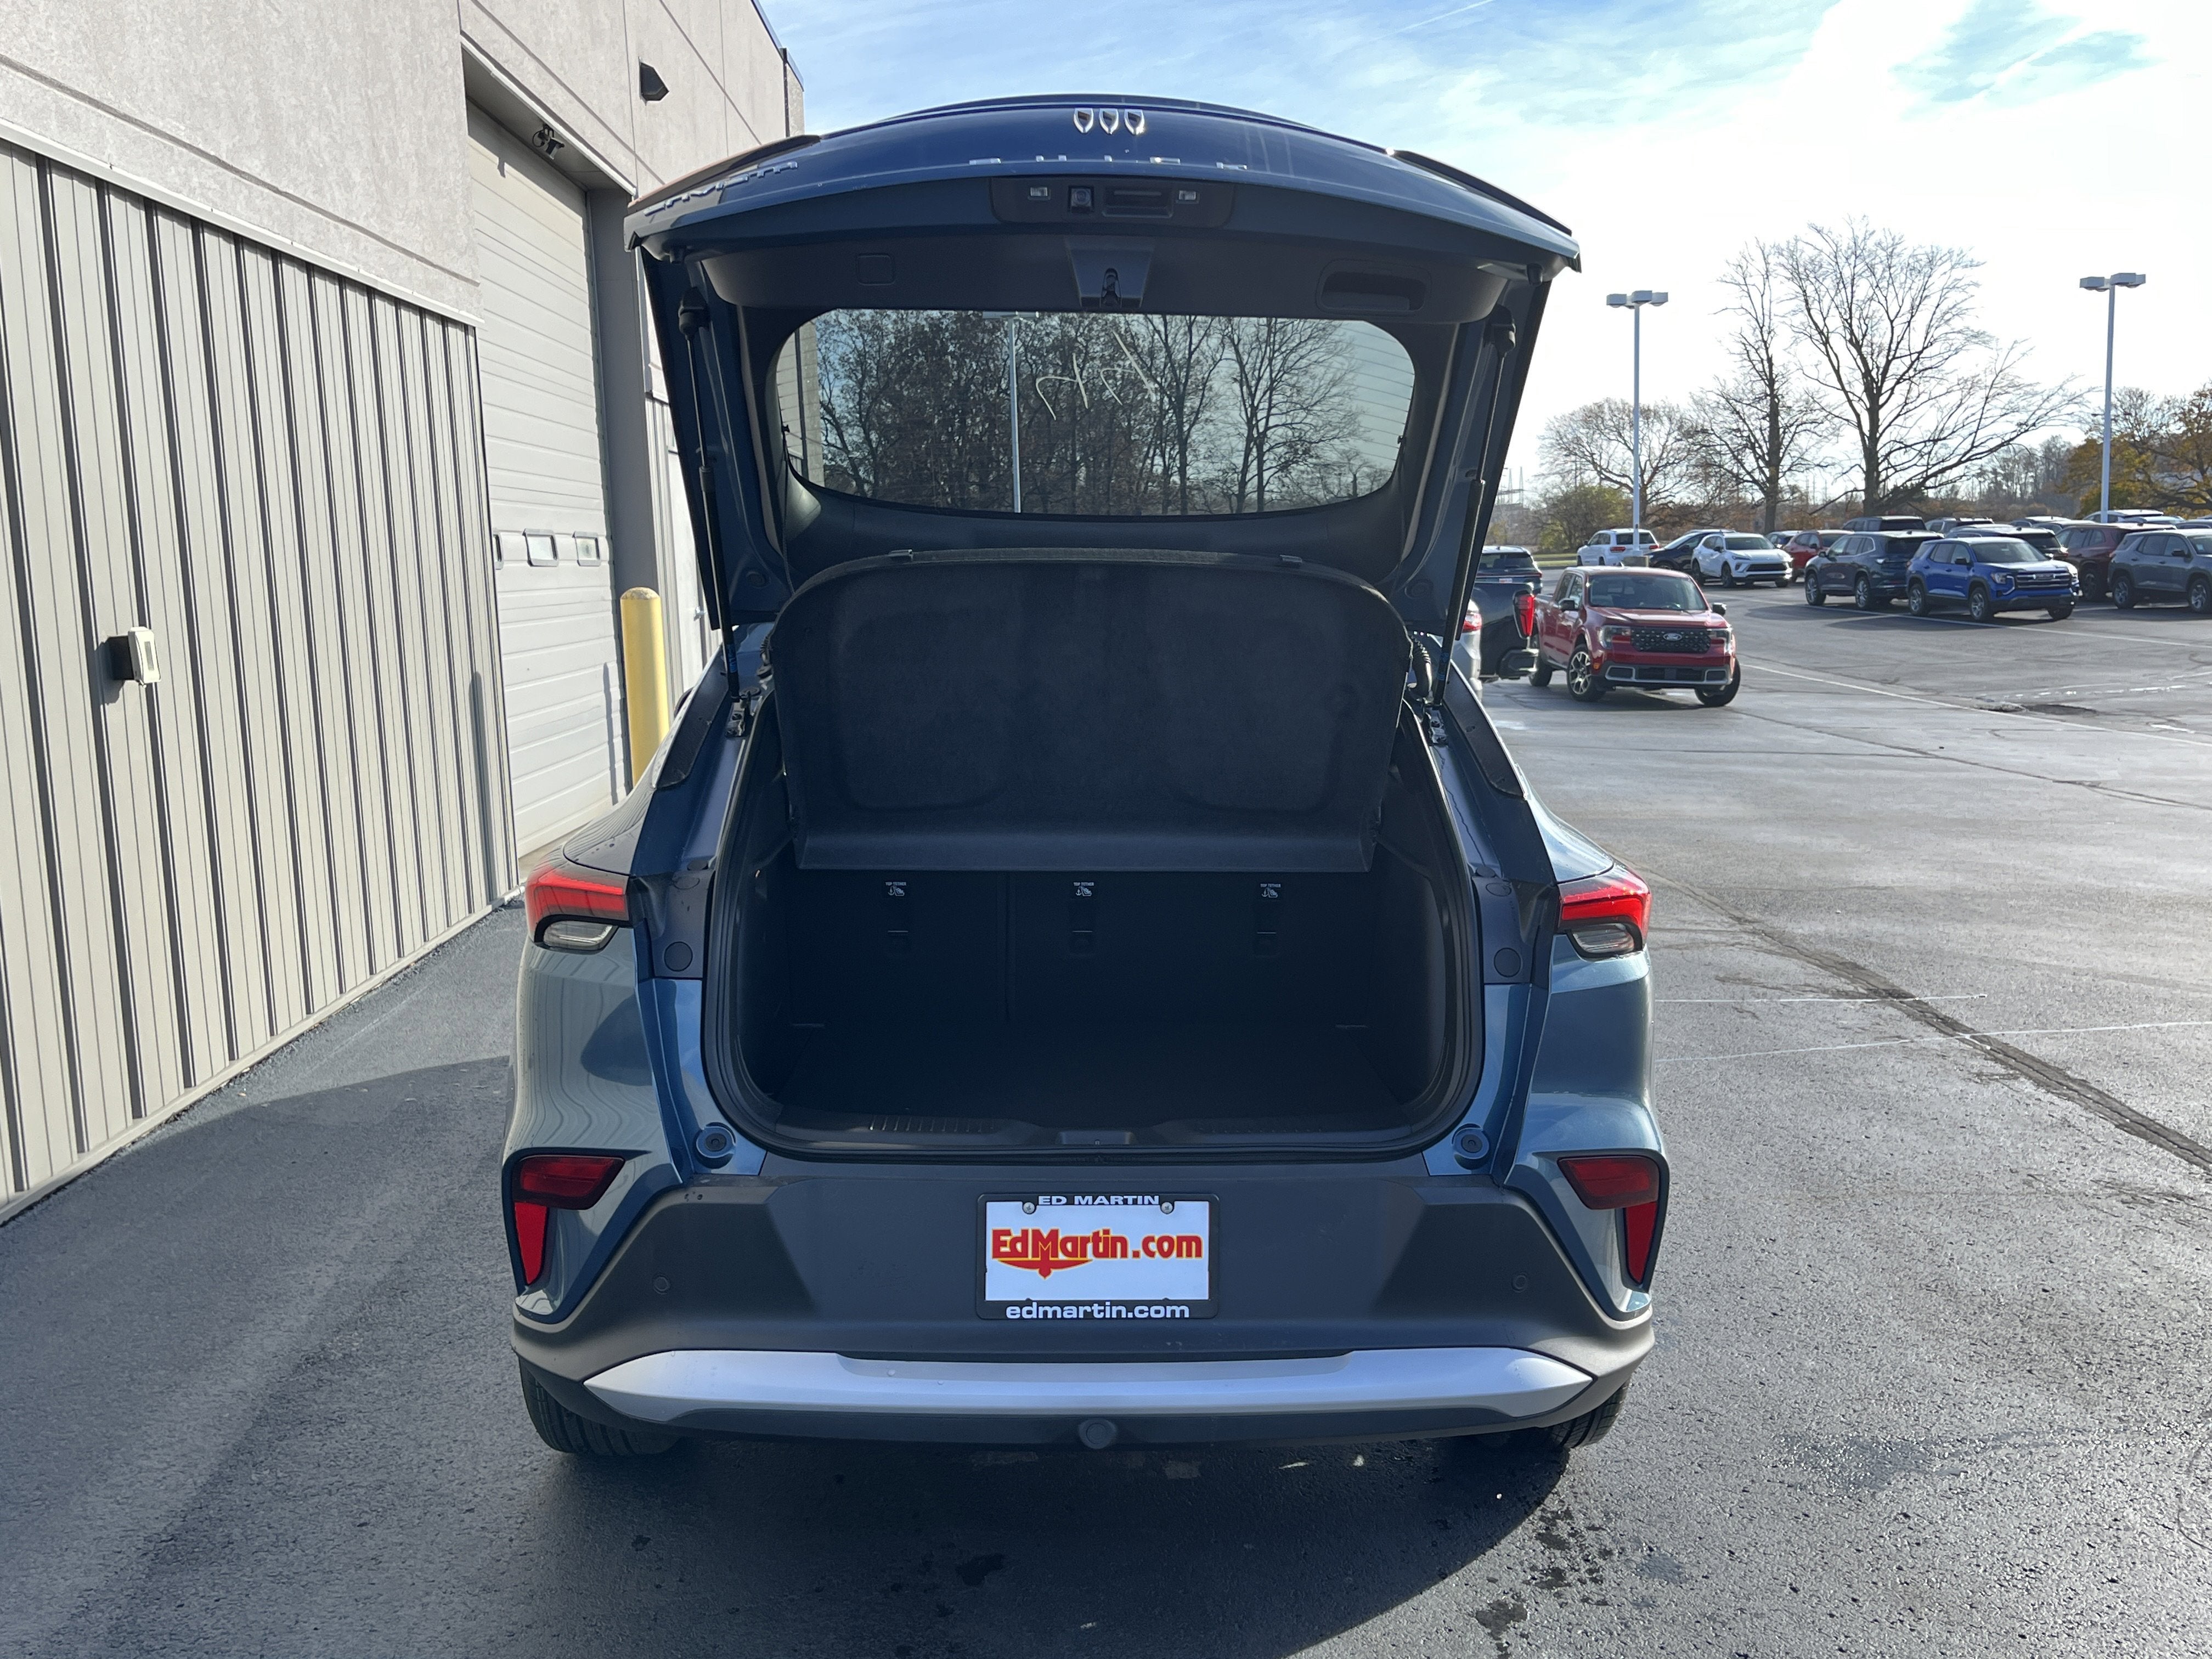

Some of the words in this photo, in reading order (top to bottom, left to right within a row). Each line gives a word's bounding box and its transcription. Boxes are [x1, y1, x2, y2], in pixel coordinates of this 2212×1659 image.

[1039, 1195, 1067, 1205] ED
[1075, 1195, 1159, 1205] MARTIN
[991, 1228, 1203, 1273] EdMartin.com
[1006, 1301, 1189, 1319] edmartin.com
